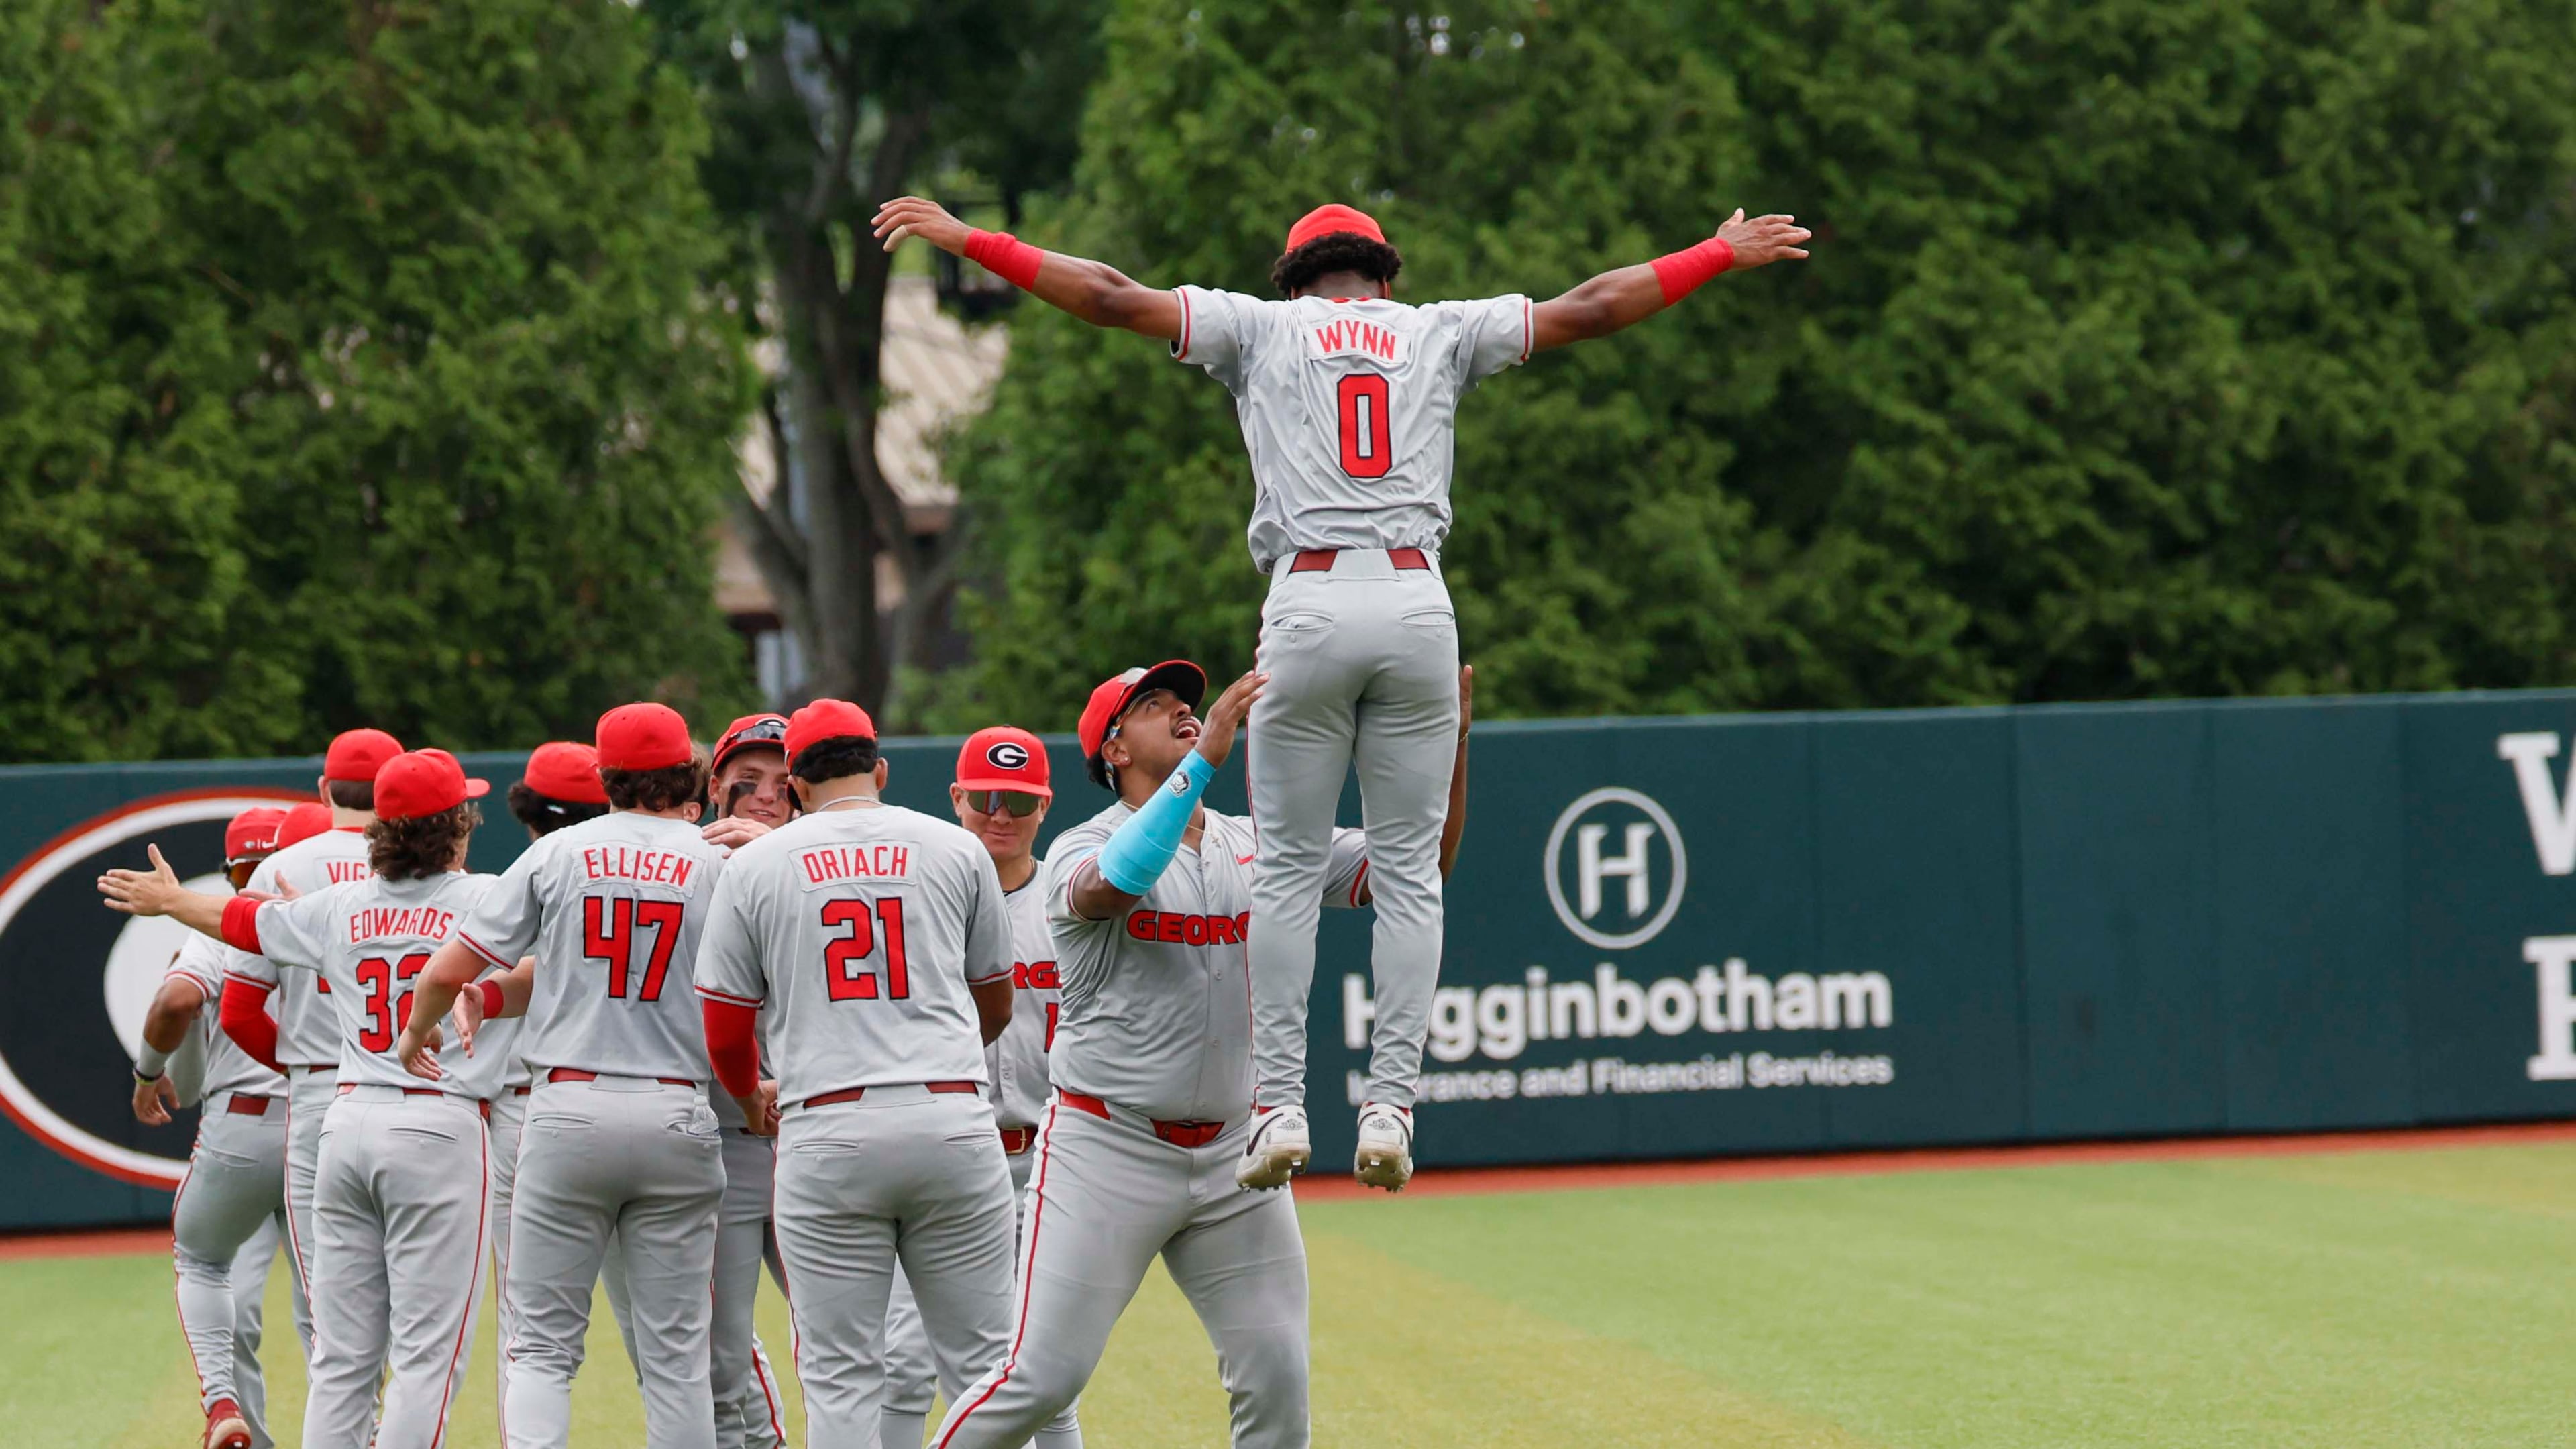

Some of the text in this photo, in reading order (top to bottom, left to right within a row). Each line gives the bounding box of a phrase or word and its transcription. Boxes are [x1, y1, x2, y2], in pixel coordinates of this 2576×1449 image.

[1316, 319, 1396, 360] WYNN
[1337, 373, 1393, 478] 0
[987, 743, 1028, 769] G
[326, 861, 375, 885] VIG
[584, 847, 693, 888] ELLISEN
[802, 845, 908, 884] ORIACH
[1578, 822, 1656, 920] H
[350, 907, 453, 943] EDWARDS
[583, 896, 684, 1002] 47
[820, 896, 910, 1002] 21
[1343, 957, 1893, 1063] Hgginbotham
[1520, 1060, 1589, 1097] and
[1592, 1052, 1744, 1094] Financial
[1748, 1049, 1894, 1088] Services
